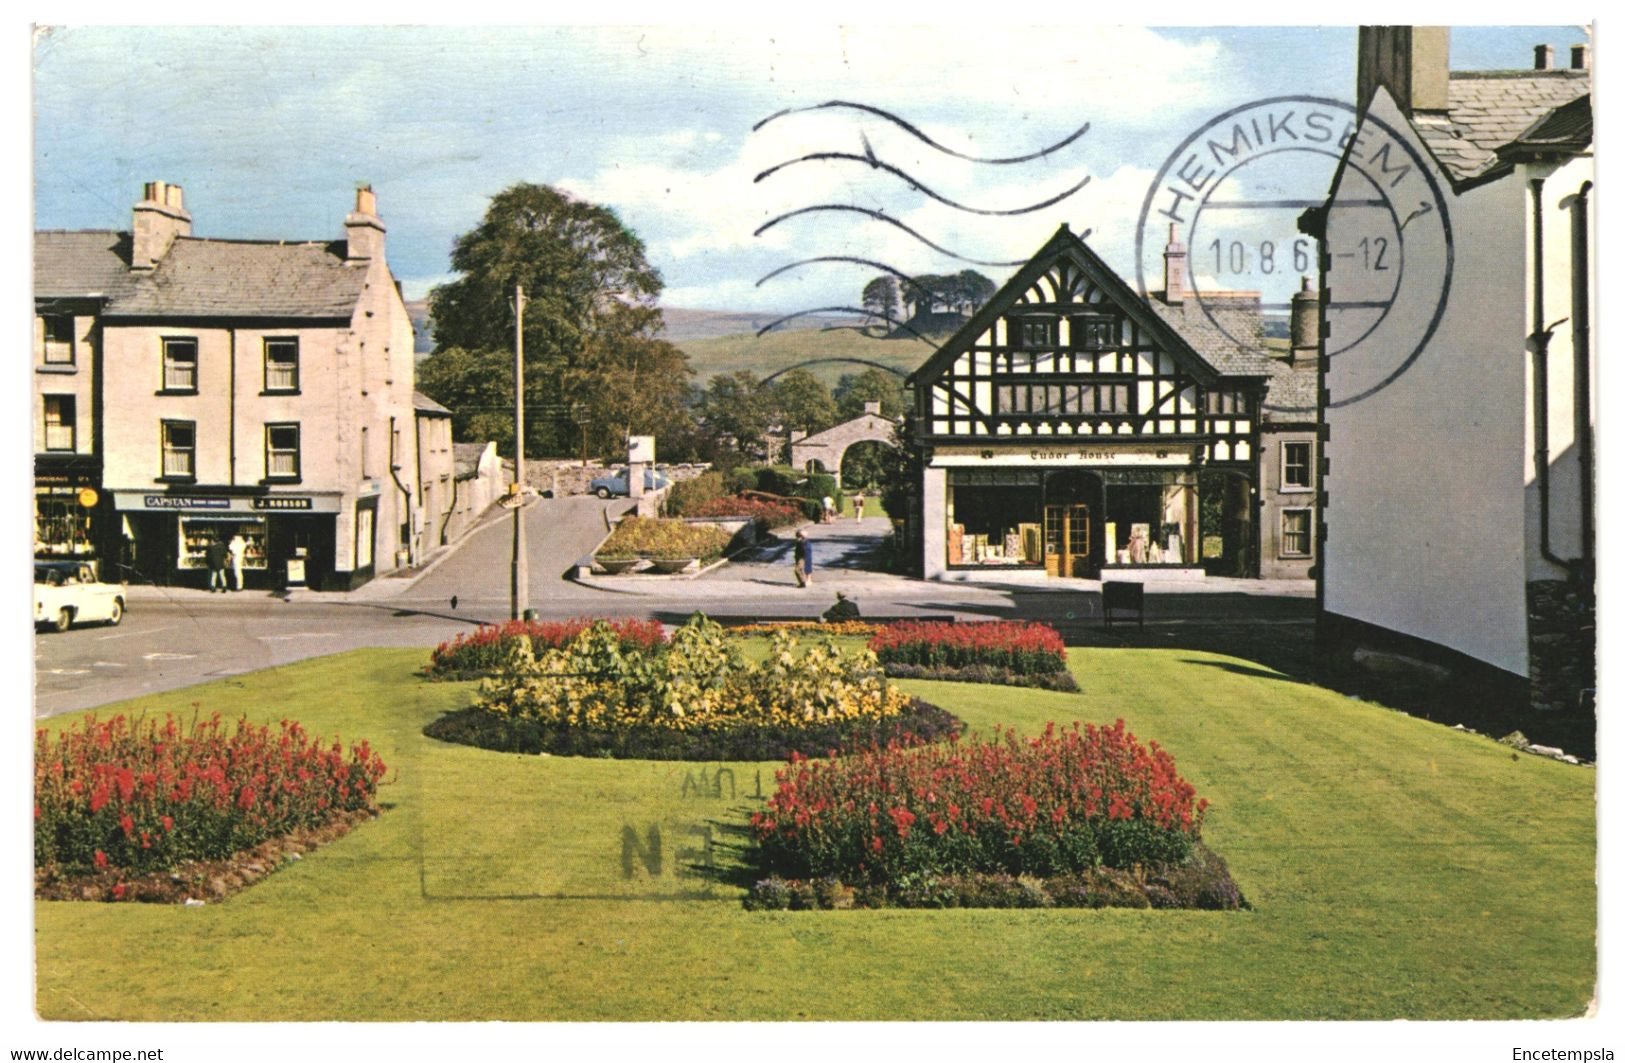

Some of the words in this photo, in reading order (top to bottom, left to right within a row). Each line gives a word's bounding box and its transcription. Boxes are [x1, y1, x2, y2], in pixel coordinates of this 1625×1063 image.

[1158, 110, 1411, 223] HEMIKSEM
[1030, 449, 1069, 460] Tudor
[1078, 449, 1116, 460] House
[146, 497, 192, 508] CAPSTAN
